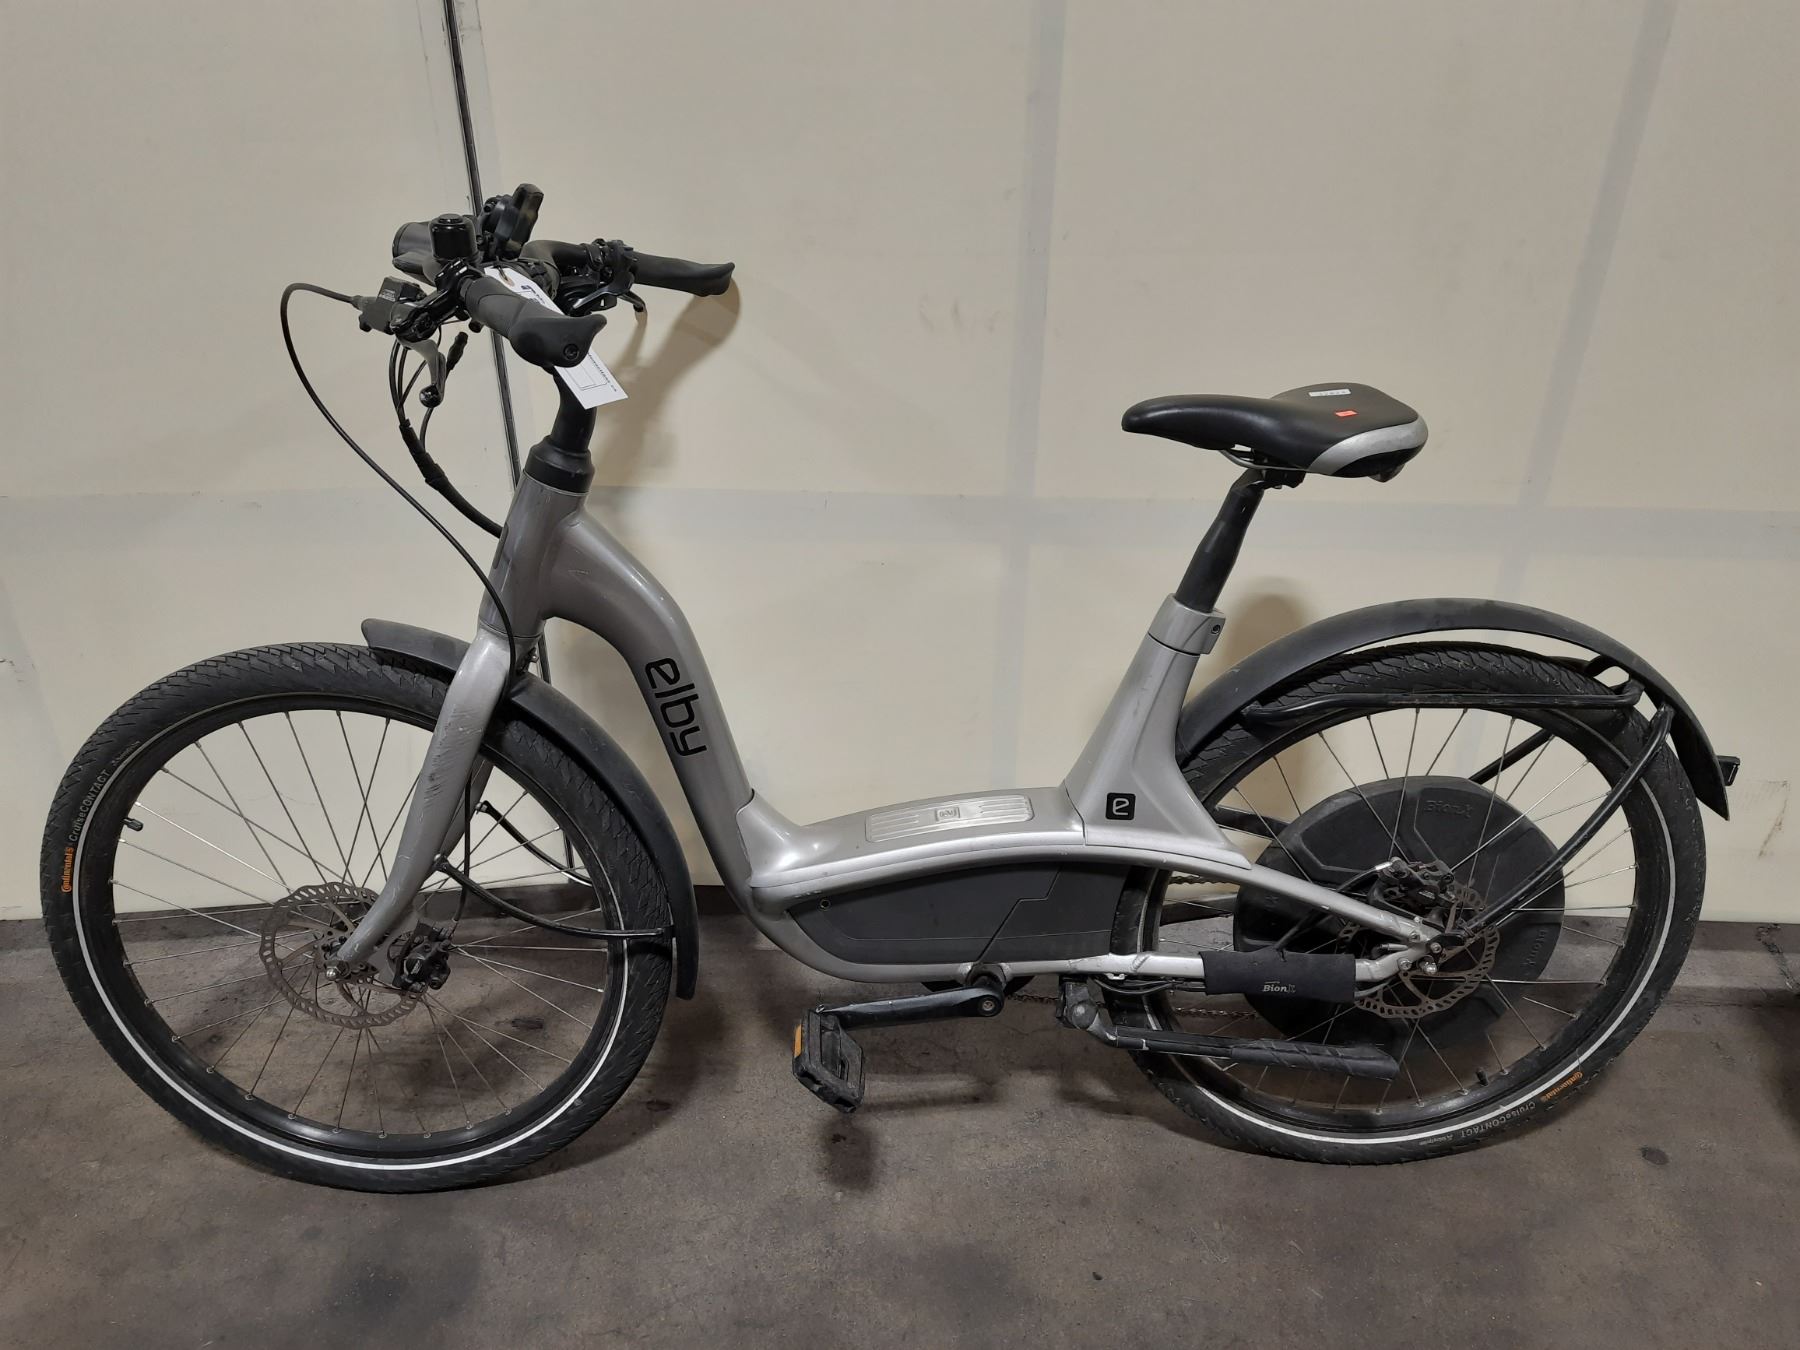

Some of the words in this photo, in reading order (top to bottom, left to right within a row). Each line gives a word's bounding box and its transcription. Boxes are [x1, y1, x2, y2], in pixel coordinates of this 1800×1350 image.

[645, 657, 707, 756] elby
[68, 769, 111, 842] CruiseCONTACT
[1112, 797, 1130, 816] e
[1461, 1102, 1536, 1138] CruiseCONTACT
